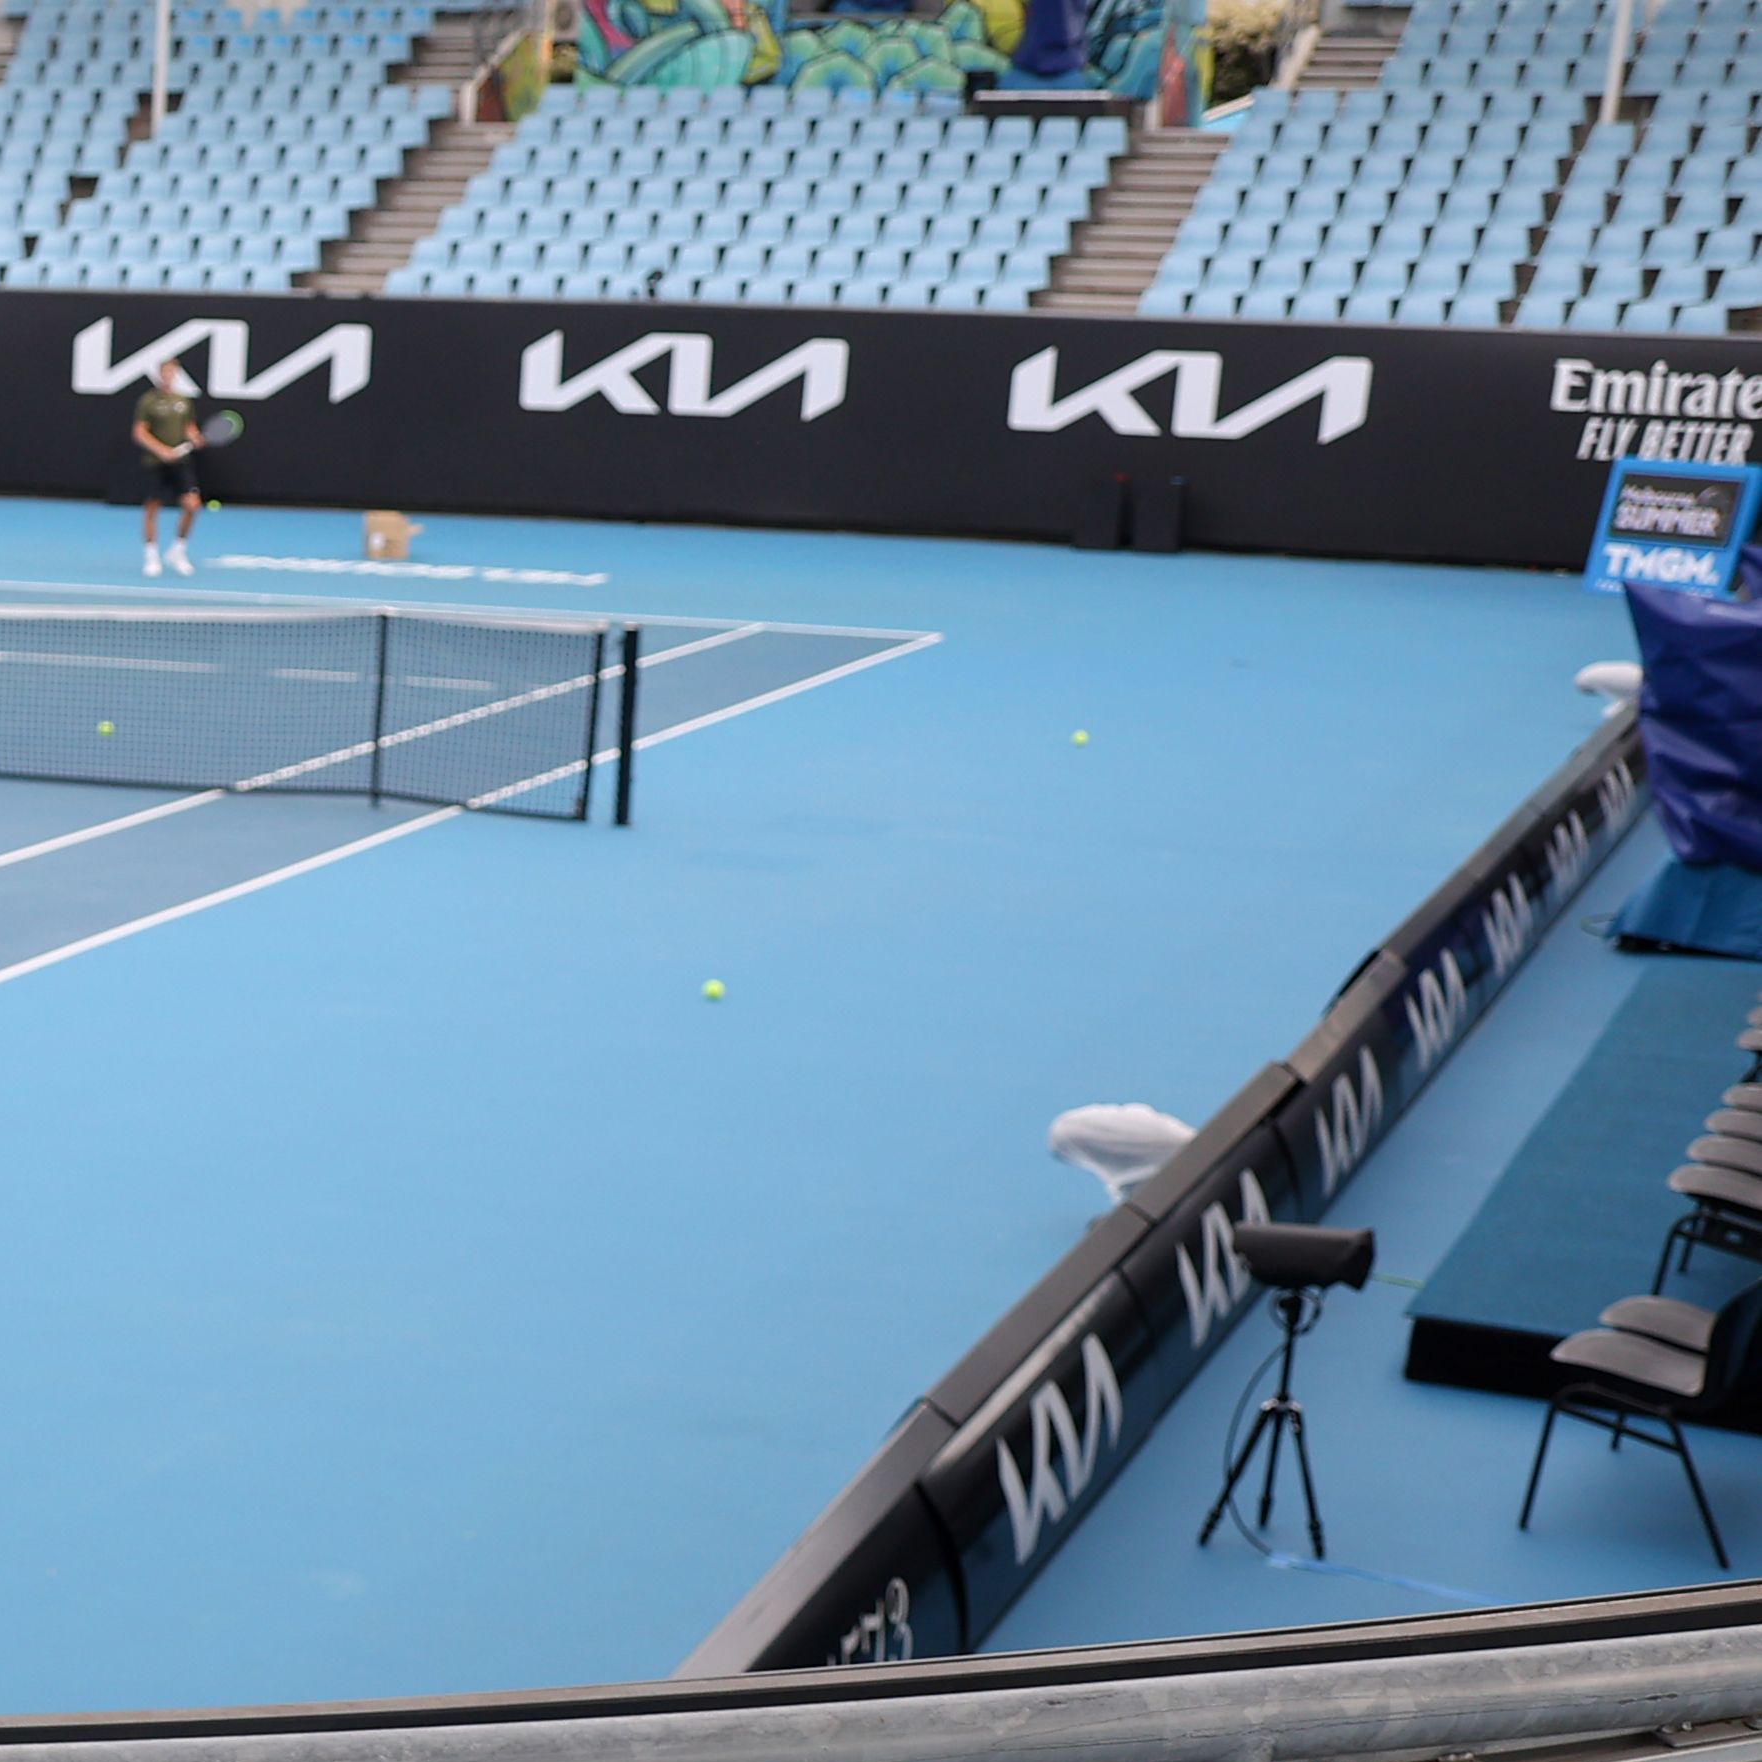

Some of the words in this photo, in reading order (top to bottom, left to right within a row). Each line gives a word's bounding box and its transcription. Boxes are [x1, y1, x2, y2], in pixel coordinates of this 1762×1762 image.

[72, 317, 372, 403] KIA
[519, 329, 849, 421] KIA
[1007, 346, 1373, 444] KIA
